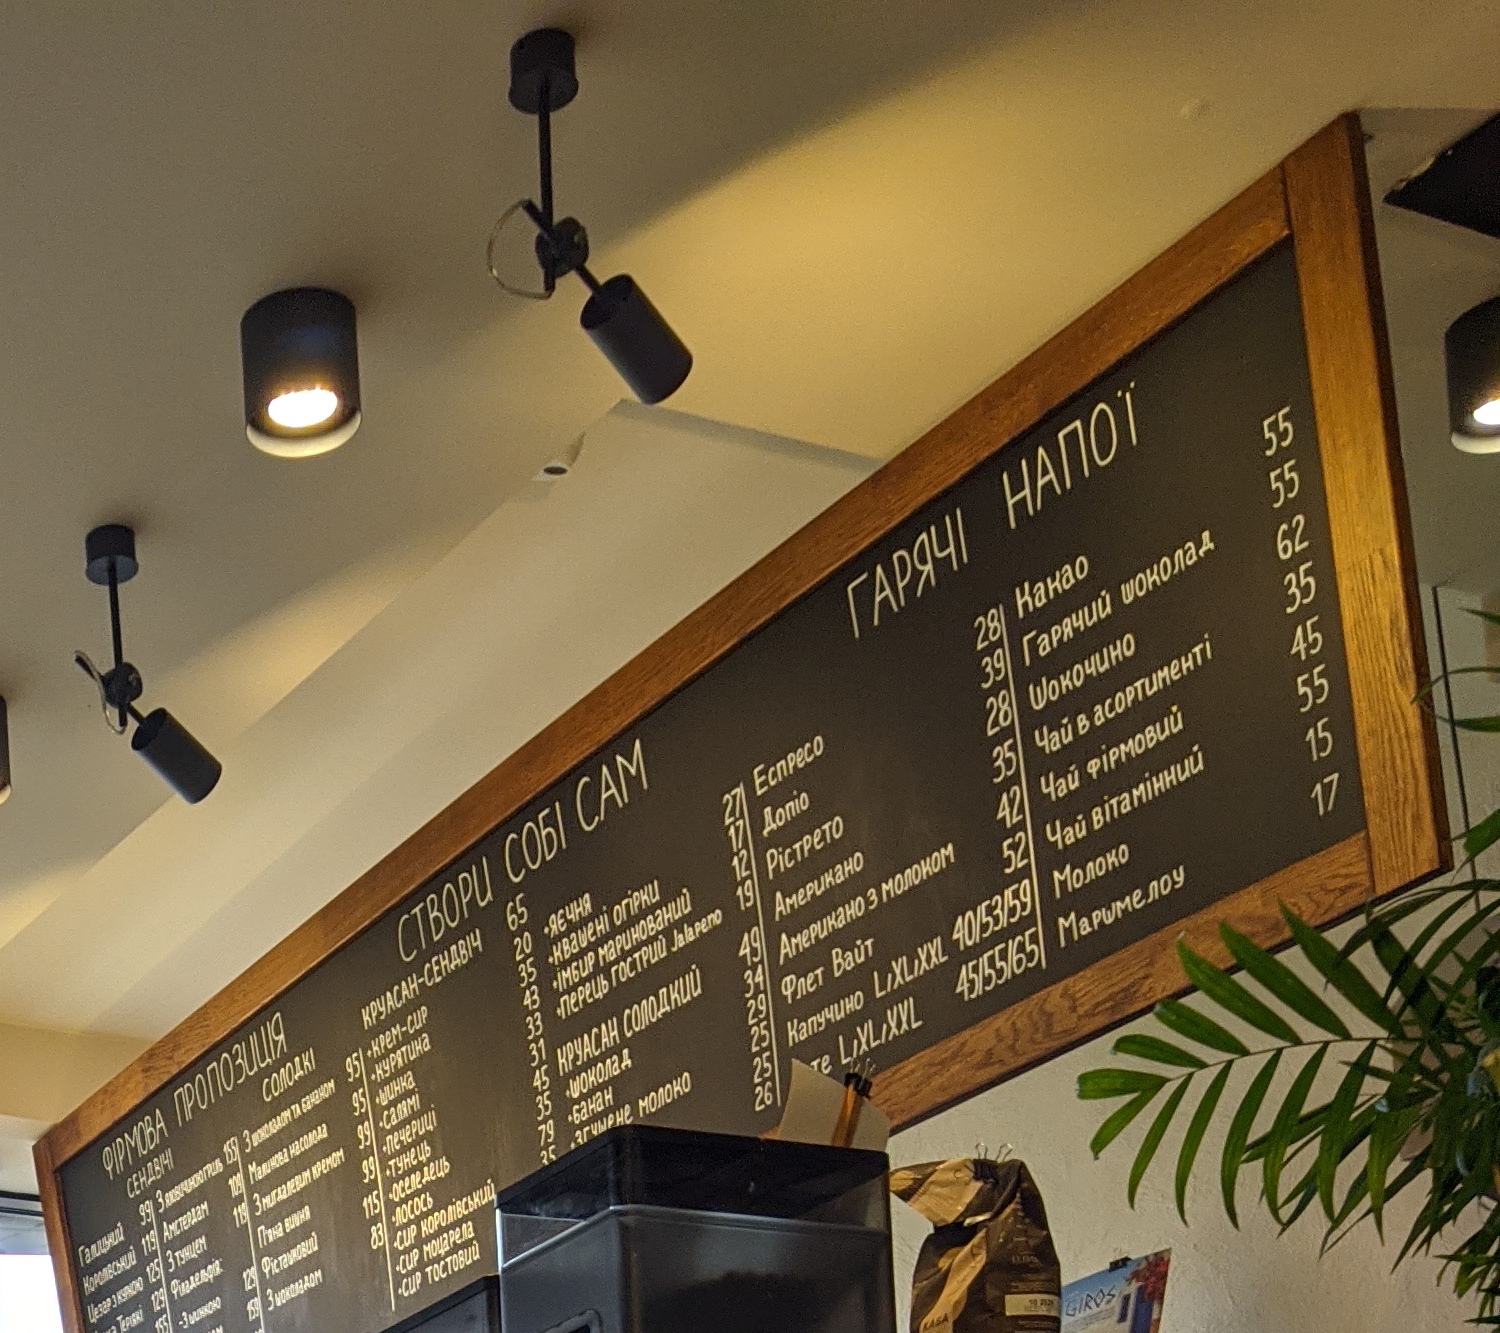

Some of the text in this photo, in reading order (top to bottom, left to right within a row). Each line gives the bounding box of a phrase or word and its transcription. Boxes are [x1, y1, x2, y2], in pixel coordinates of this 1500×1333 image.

[848, 382, 1136, 638] ГАРЯЧІ НАПОЇ
[1016, 407, 1293, 618] Какао 55
[1023, 460, 1299, 666] Гарячий шоколад 55
[1029, 515, 1309, 710] Шокочино 62
[1035, 717, 1073, 753] Чай
[1094, 634, 1211, 726] асортименті
[1284, 561, 1315, 613] 35
[753, 607, 1004, 795] Еспресо 28
[1041, 616, 1322, 801] Чай фірмовий 45
[763, 648, 1005, 837] Допіо 39
[1046, 664, 1328, 849] Чай вітамінний 55
[766, 690, 1012, 879] Рістрето 28
[723, 788, 742, 826] 27
[1053, 718, 1332, 898] Молоко 15
[729, 819, 744, 852] 17
[776, 739, 1016, 921] Американо 35
[399, 739, 647, 961] СТВОРИ СОБІ САМ
[732, 848, 750, 881] 12
[1058, 773, 1339, 947] Маршмелоу 17
[780, 896, 865, 965] Американо
[882, 843, 954, 902] молоком
[997, 786, 1023, 828] 42
[737, 879, 753, 910] 19
[781, 832, 1028, 1003] Флет Вайт 52
[362, 893, 527, 1029] КРУАСАН-СЕНДВІЧ 65
[514, 932, 532, 961] 20
[787, 991, 863, 1046] Капучино
[953, 879, 1031, 950] 40/53/59
[956, 927, 1038, 1001] 45/55/65
[519, 957, 537, 987] 35
[744, 964, 763, 997] 34
[523, 985, 540, 1010] 43
[557, 926, 761, 1076] КРУАСАН СОЛОДКИЙ 49
[747, 994, 766, 1027] 29
[526, 1012, 542, 1039] 33
[751, 1021, 769, 1052] 25
[346, 1051, 364, 1082] 95
[529, 1038, 546, 1066] 31
[753, 1051, 771, 1083] 25
[263, 1048, 315, 1101] СОЛОДКІ
[533, 1065, 549, 1091] 45
[103, 1012, 287, 1179] ФІРМОВА ПРОПОЗИЦІЯ
[353, 1088, 369, 1116] 95
[536, 1091, 551, 1120] 35
[755, 1082, 772, 1111] 26
[358, 1121, 374, 1149] 99
[538, 1120, 554, 1146] 79
[127, 1148, 173, 1198] СЕНДВІЧІ
[362, 1156, 375, 1183] 99
[139, 1200, 151, 1225] 99
[163, 1201, 208, 1242] Амстердам
[363, 1190, 383, 1218] 115
[371, 1223, 387, 1249] 83
[146, 1259, 163, 1283] 125
[1065, 1284, 1117, 1317] GIROS
